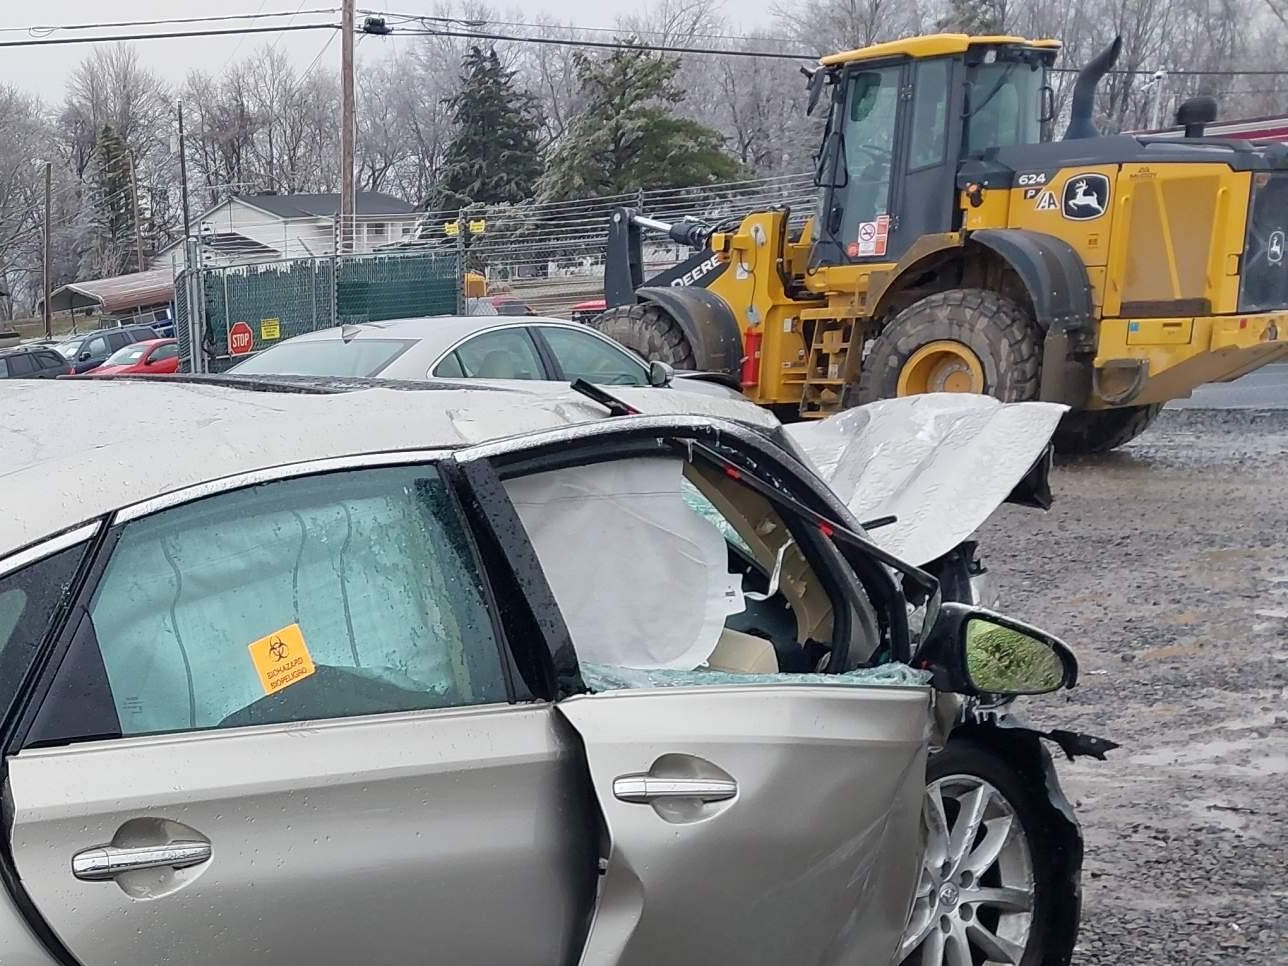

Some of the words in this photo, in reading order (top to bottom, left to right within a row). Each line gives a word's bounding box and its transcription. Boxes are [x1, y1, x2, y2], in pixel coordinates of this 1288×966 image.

[1018, 173, 1047, 185] 624
[671, 253, 723, 287] DEERE
[232, 333, 250, 348] STOP
[267, 657, 304, 680] BIOHAZARD
